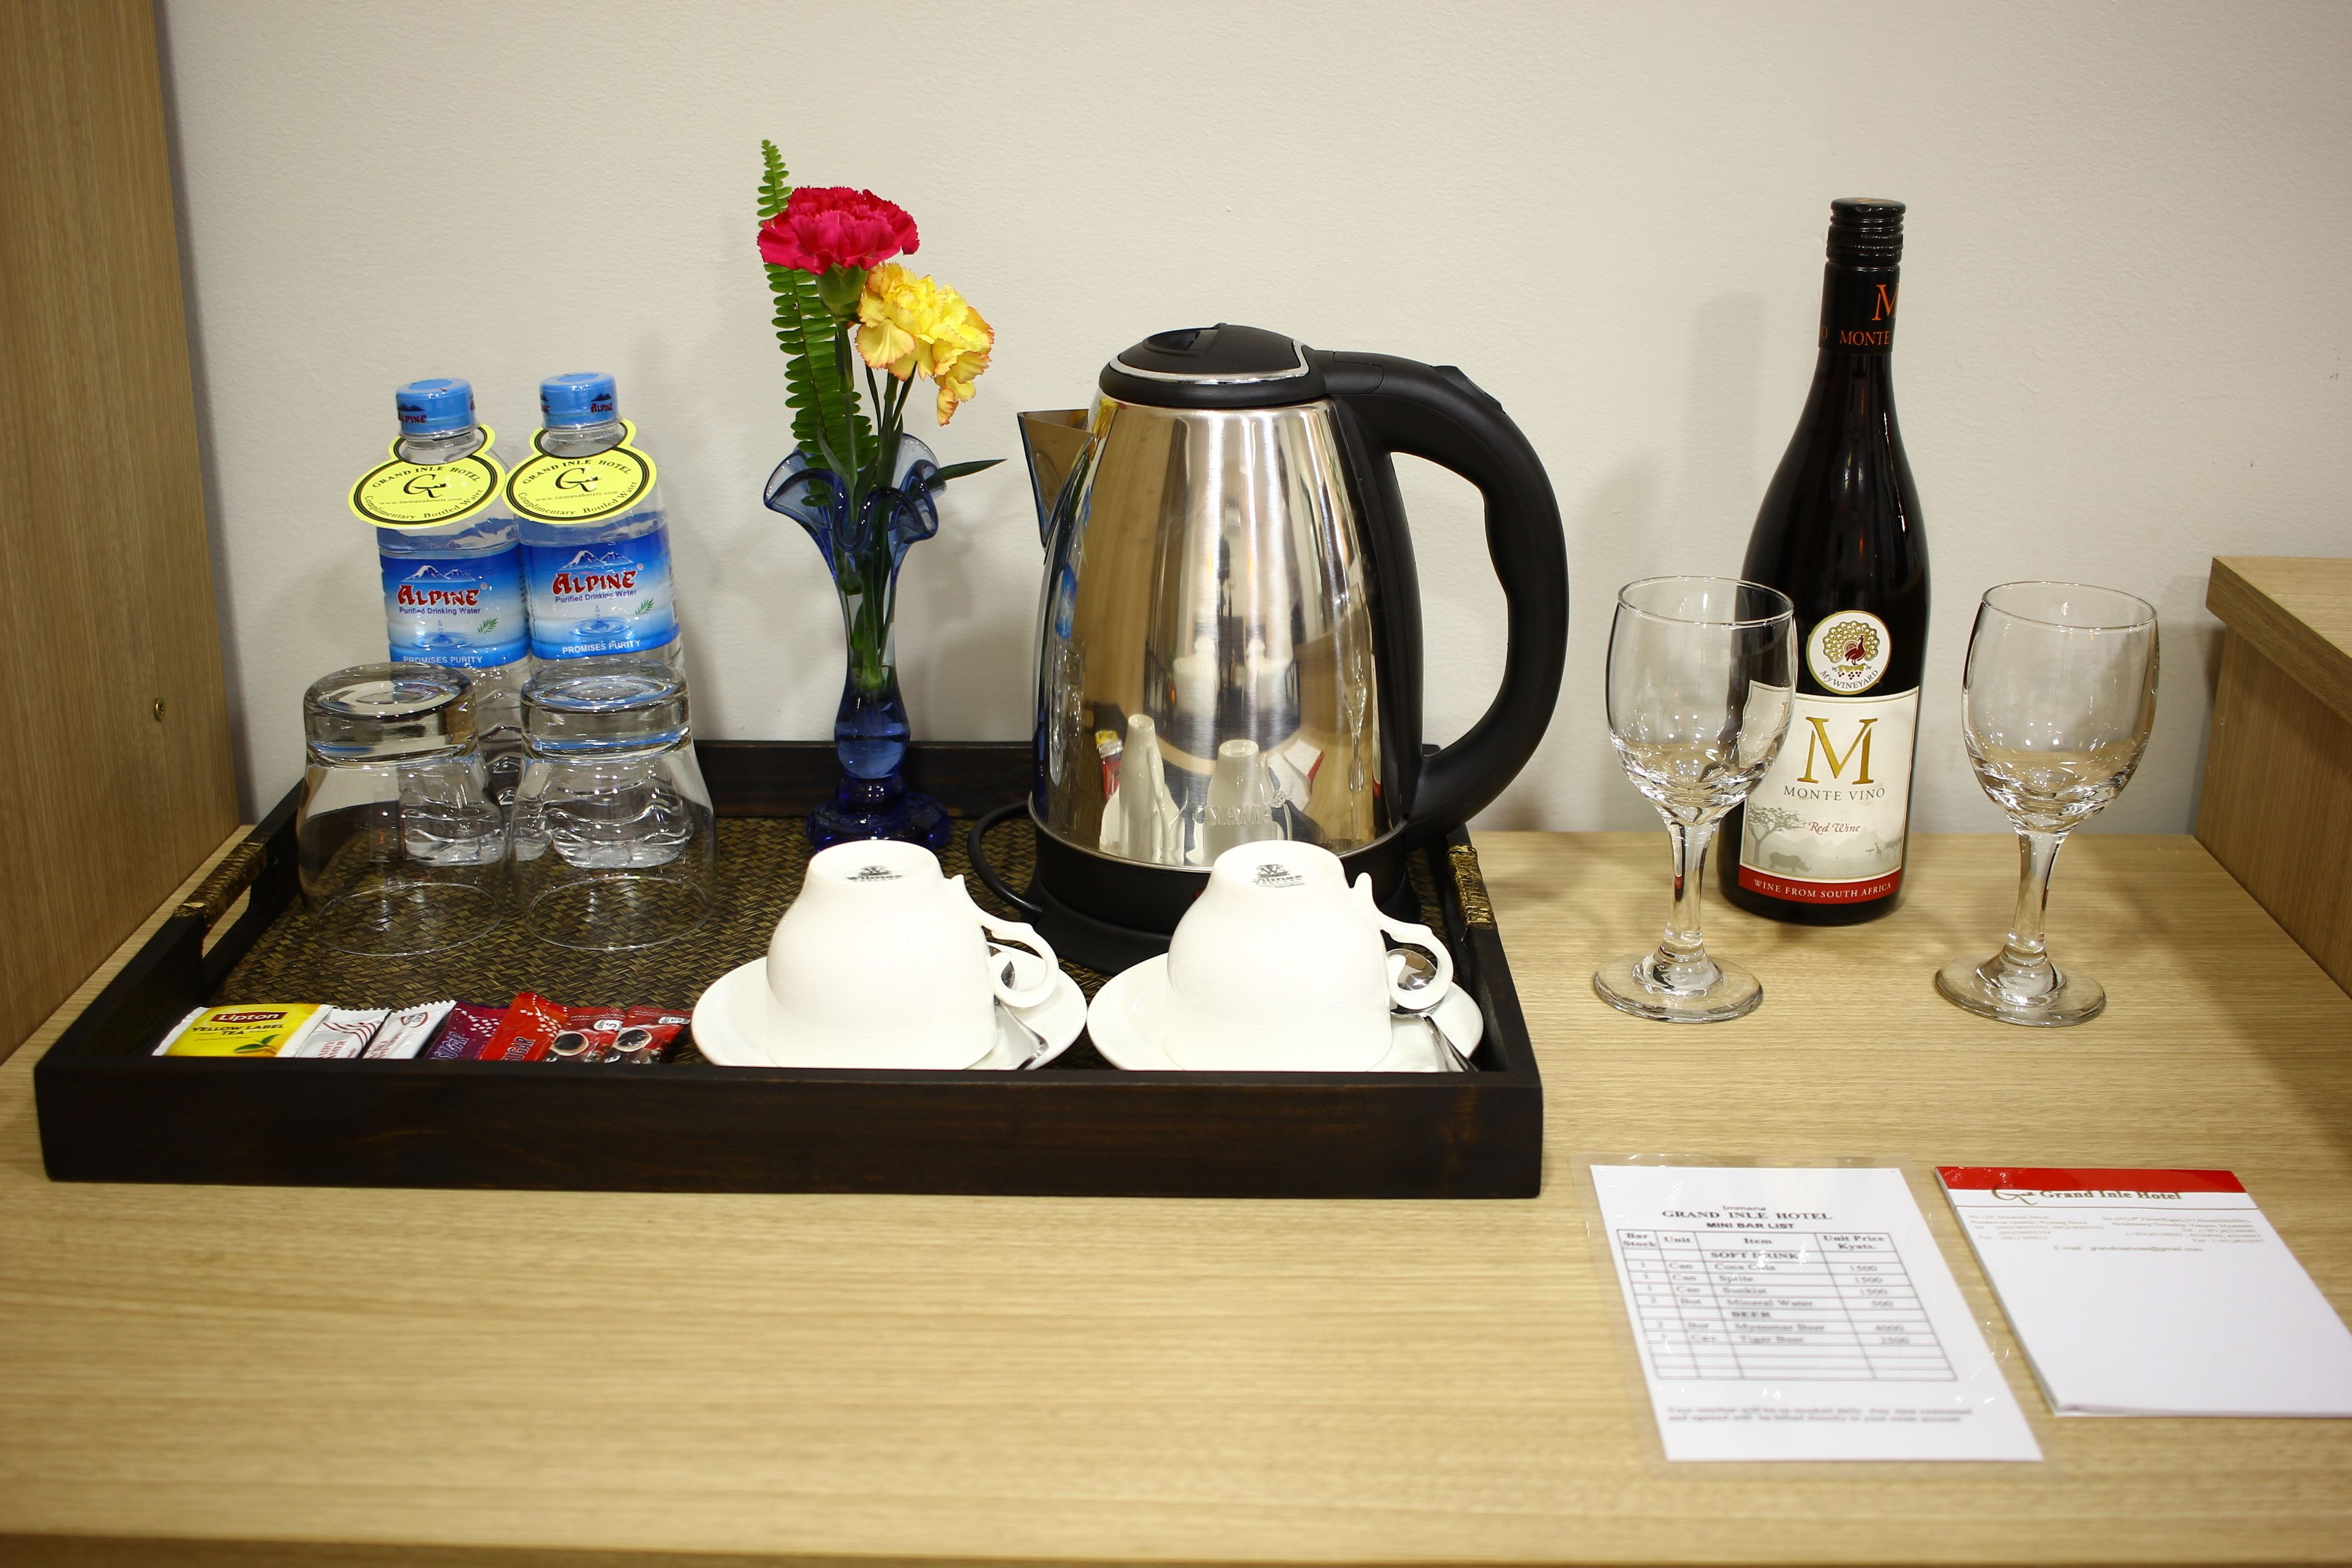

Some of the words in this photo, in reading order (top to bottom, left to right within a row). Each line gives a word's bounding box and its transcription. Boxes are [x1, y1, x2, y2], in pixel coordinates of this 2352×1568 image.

[1839, 330, 1890, 346] MONTE
[372, 470, 412, 488] GRAND
[450, 467, 481, 482] HOTEL
[522, 464, 559, 484] GRAND
[598, 460, 633, 475] HOTEL
[364, 496, 417, 519] Complimentary
[423, 505, 461, 519] Bottled
[459, 489, 484, 507] Water
[518, 492, 576, 516] Complimentary
[582, 499, 619, 513] Bottled
[617, 481, 638, 500] Water
[552, 570, 638, 595] ALPINE
[398, 584, 480, 606] ALPINE
[555, 594, 583, 603] Purified
[585, 592, 613, 601] Drinking
[562, 643, 606, 655] PROMISES
[609, 639, 642, 649] PURITY
[1796, 716, 1878, 785] M
[1784, 786, 1842, 801] MONTE
[1849, 788, 1885, 801] VINO
[1808, 821, 1831, 835] Red
[1831, 823, 1860, 833] Wine
[1754, 878, 1781, 894] WINE
[1785, 887, 1815, 897] FROM
[1821, 890, 1857, 899] SOUTH
[1861, 882, 1891, 897] AFRICA
[218, 1012, 279, 1022] Lipton
[2040, 1190, 2095, 1199] Grand
[2137, 1191, 2185, 1200] Hotel
[1662, 1210, 1720, 1219] GRAND
[1728, 1211, 1769, 1220] INLE
[1776, 1212, 1833, 1221] HOTEL
